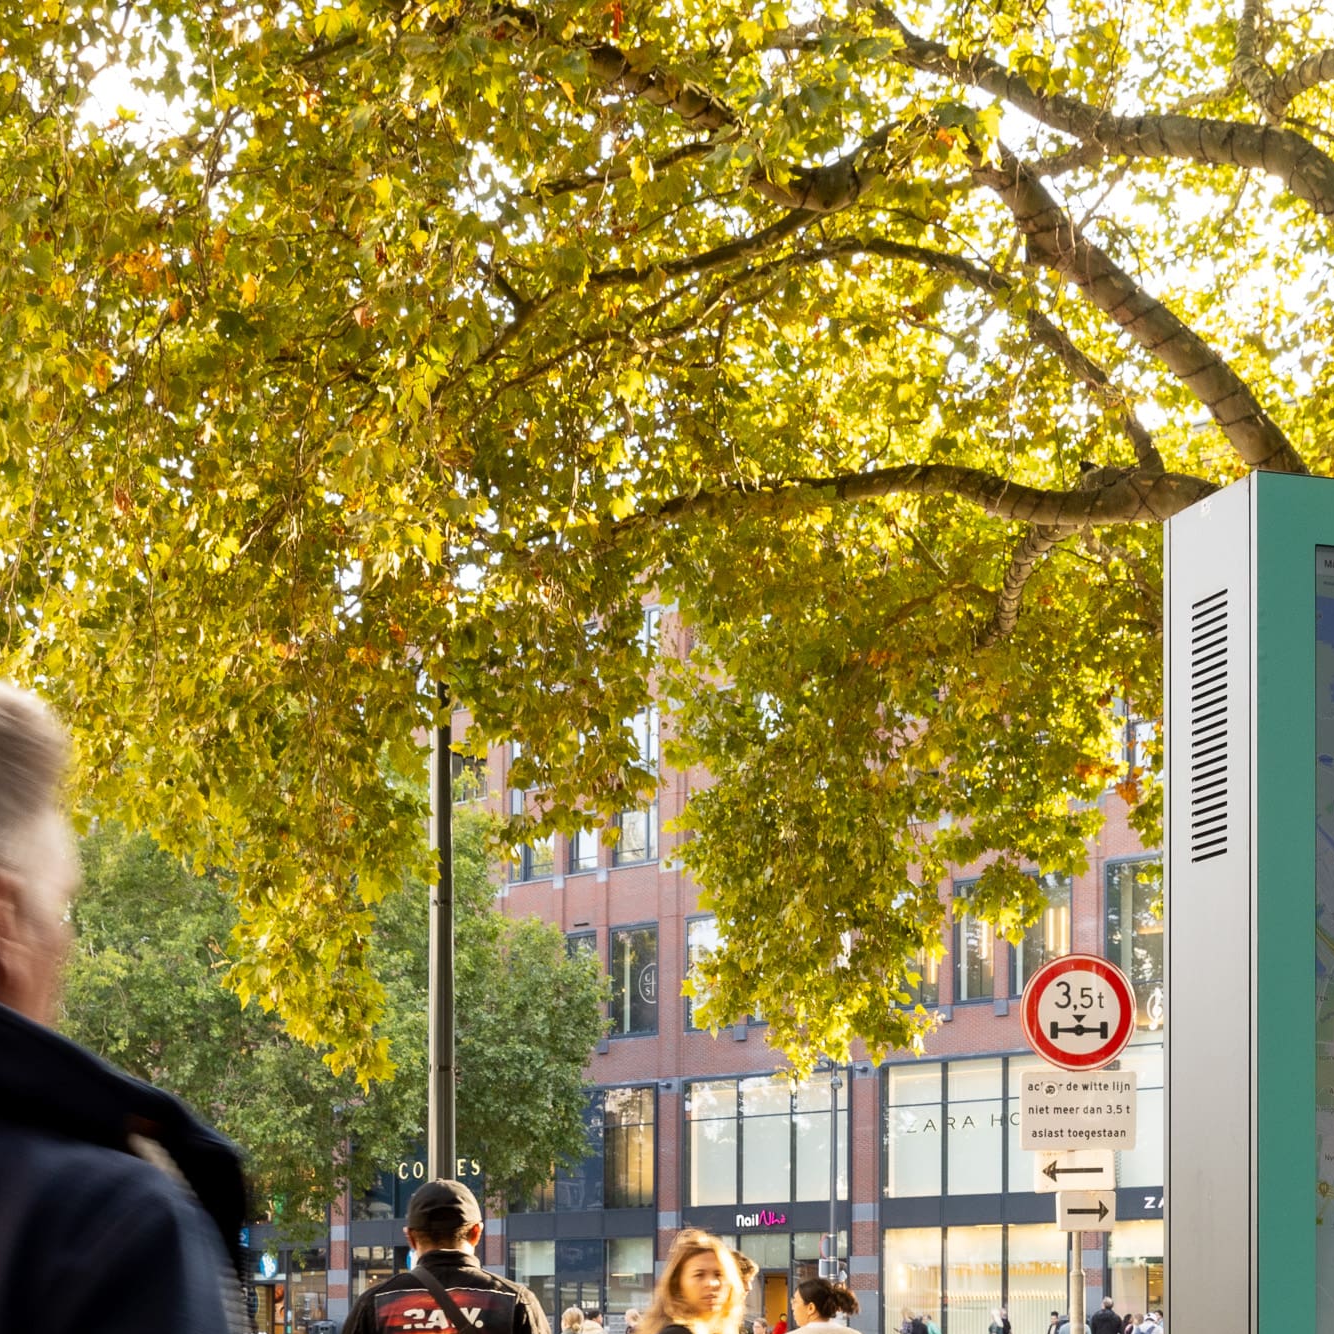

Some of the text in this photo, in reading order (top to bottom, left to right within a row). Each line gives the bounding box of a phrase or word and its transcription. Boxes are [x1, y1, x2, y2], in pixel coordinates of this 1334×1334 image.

[1066, 1081, 1079, 1092] de
[1081, 1081, 1109, 1092] witte
[1112, 1081, 1131, 1094] lijn
[1028, 1105, 1049, 1115] niet
[1053, 1106, 1080, 1115] meer
[1083, 1105, 1102, 1115] dan
[1031, 1128, 1127, 1141] aslast toegestaan
[398, 1157, 481, 1181] COES
